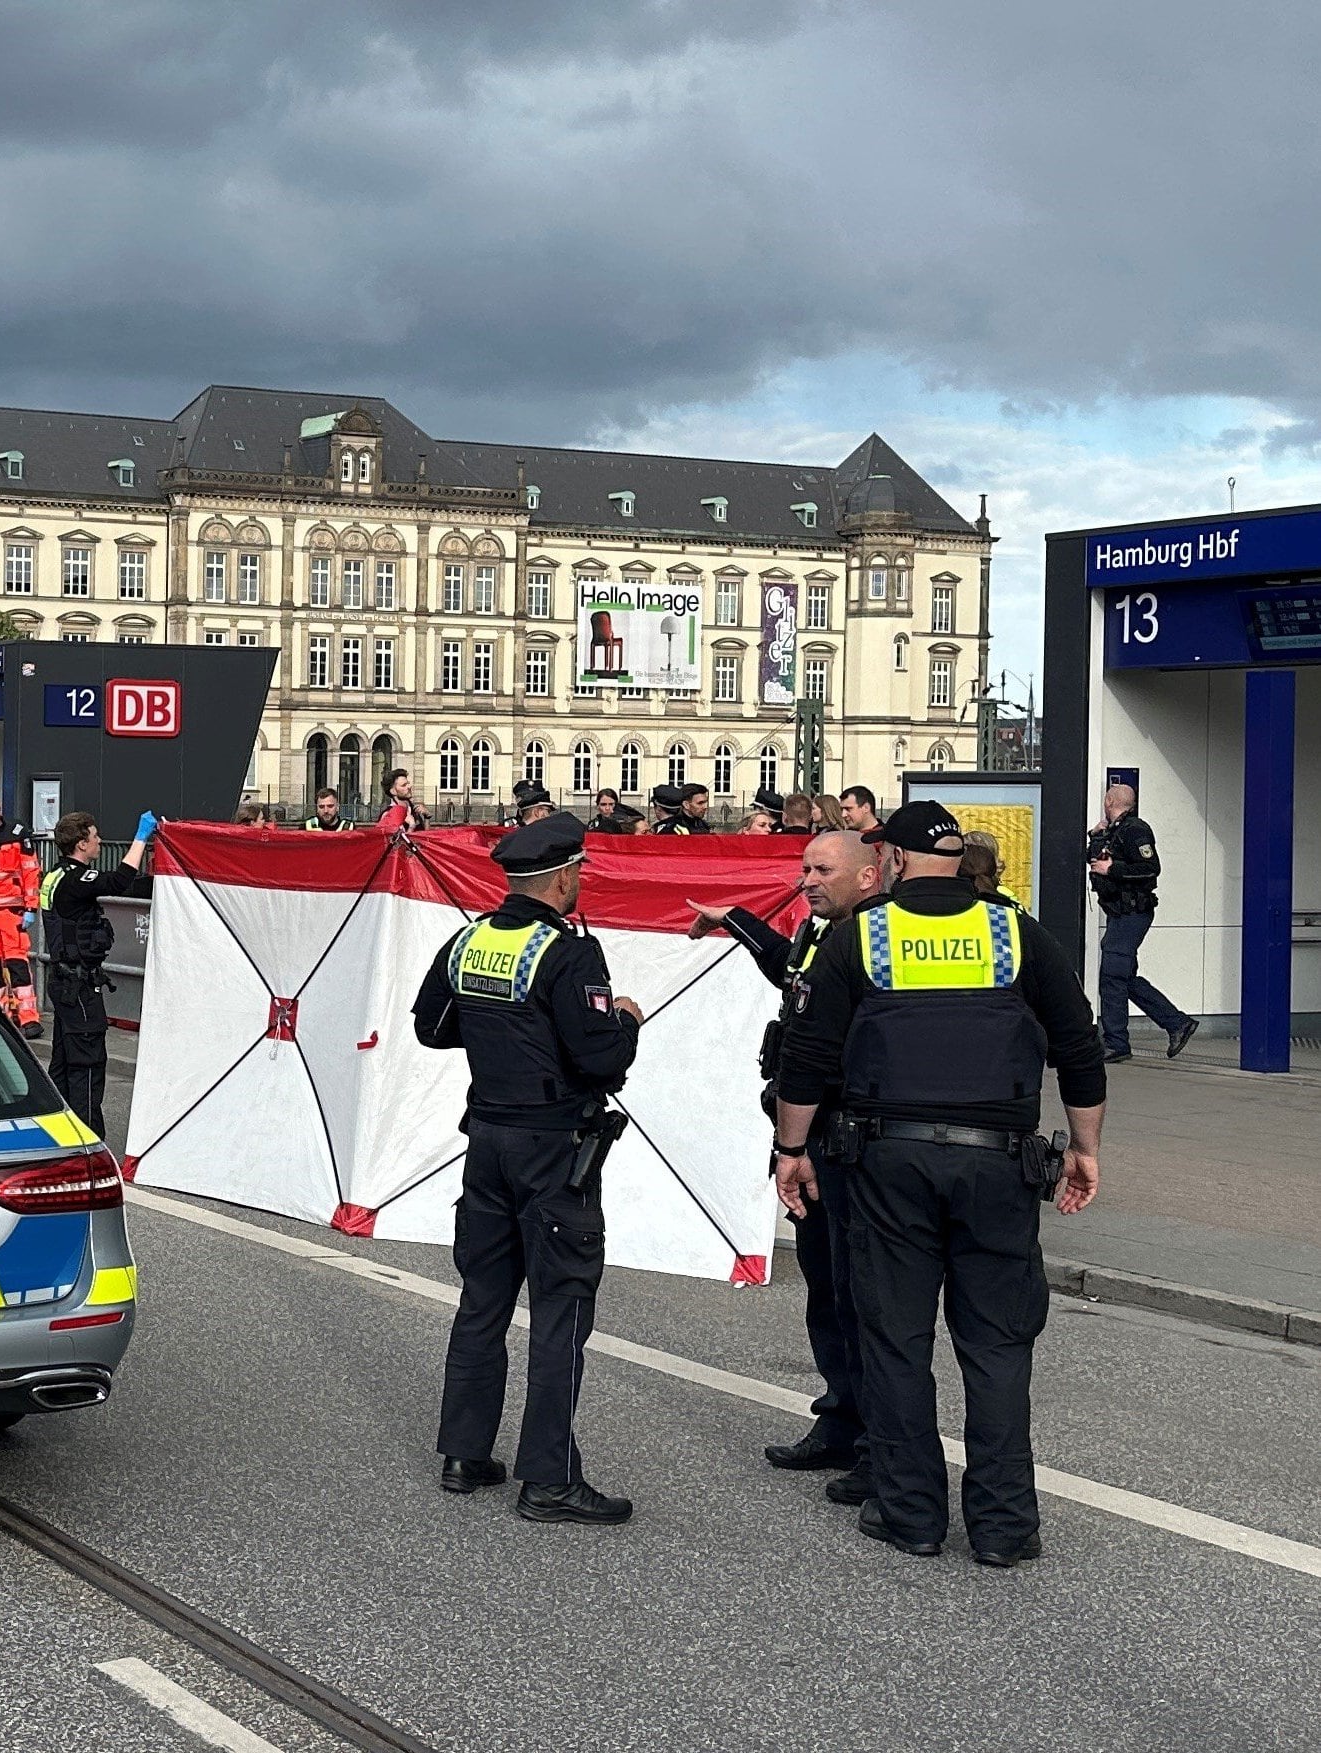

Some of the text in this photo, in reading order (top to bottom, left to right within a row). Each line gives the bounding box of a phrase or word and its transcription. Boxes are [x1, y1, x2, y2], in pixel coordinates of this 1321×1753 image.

[1096, 529, 1240, 570] Hamburg Hbf
[580, 585, 700, 616] Hello Image
[765, 586, 797, 676] Glitzer
[1116, 592, 1159, 644] 13
[66, 689, 95, 717] 12
[118, 690, 171, 727] DB
[927, 821, 959, 836] POLIZ
[464, 948, 516, 976] POLIZEI
[901, 938, 982, 962] POLIZEI
